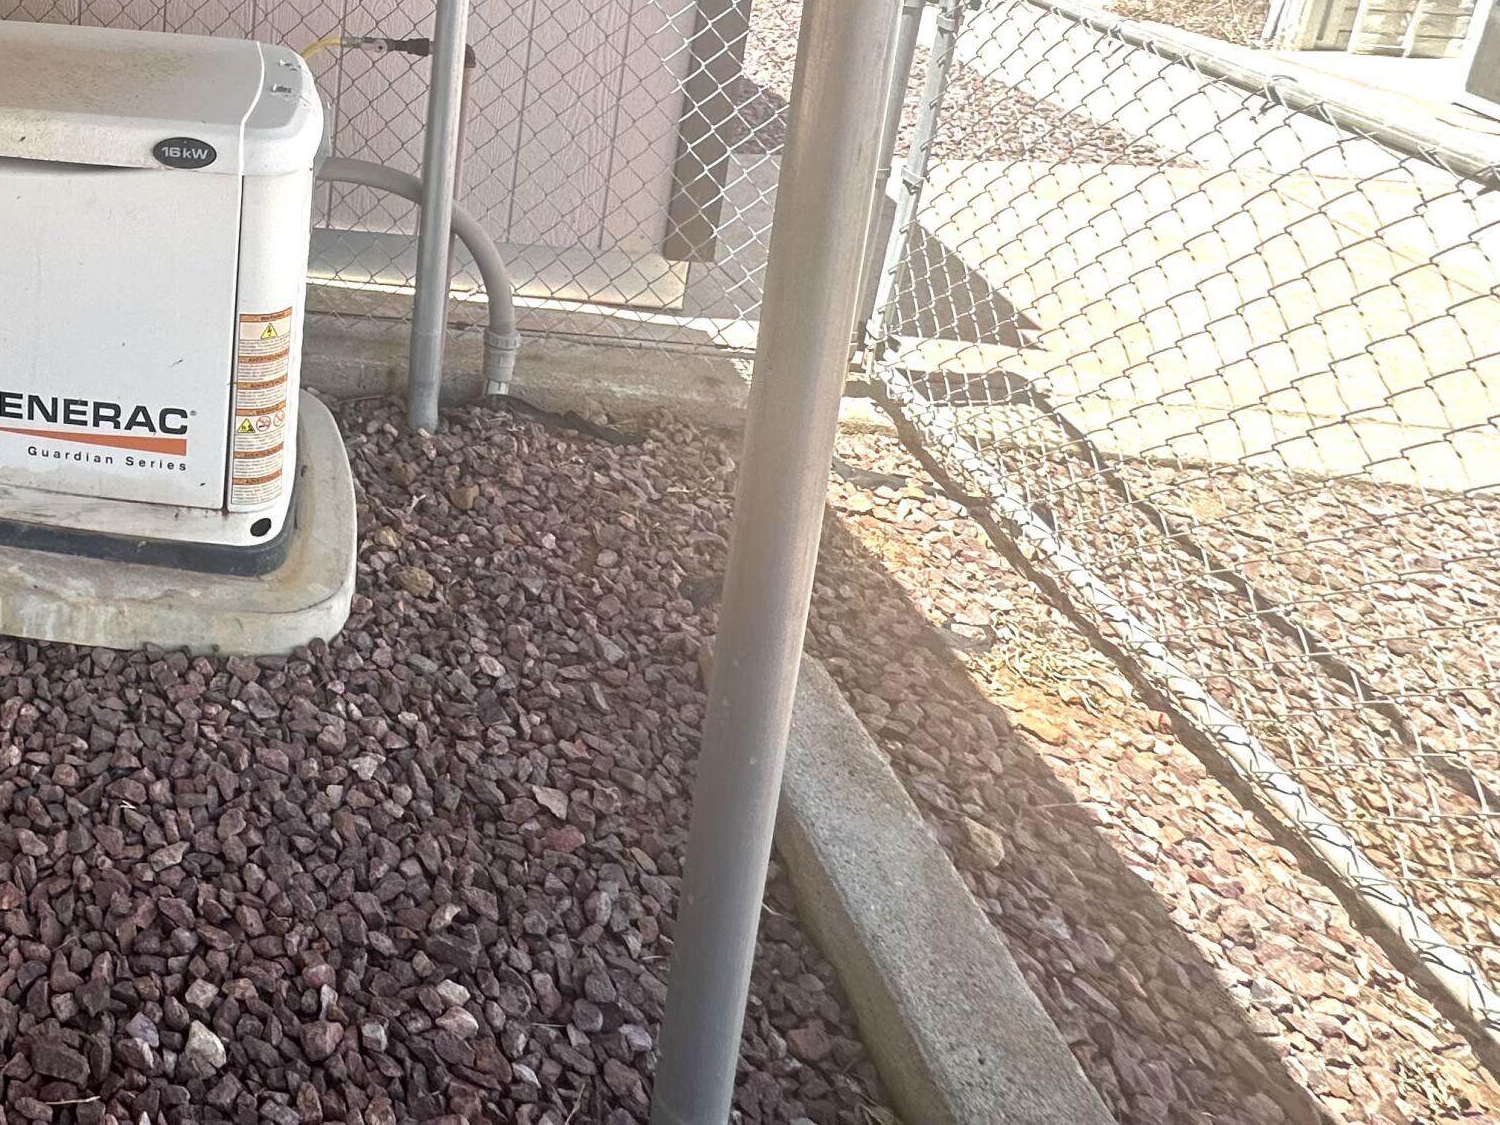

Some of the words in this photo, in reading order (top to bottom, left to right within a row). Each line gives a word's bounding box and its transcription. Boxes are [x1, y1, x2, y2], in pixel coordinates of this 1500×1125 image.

[161, 146, 181, 158] 16
[28, 446, 114, 465] Guardian
[125, 456, 187, 471] Series
